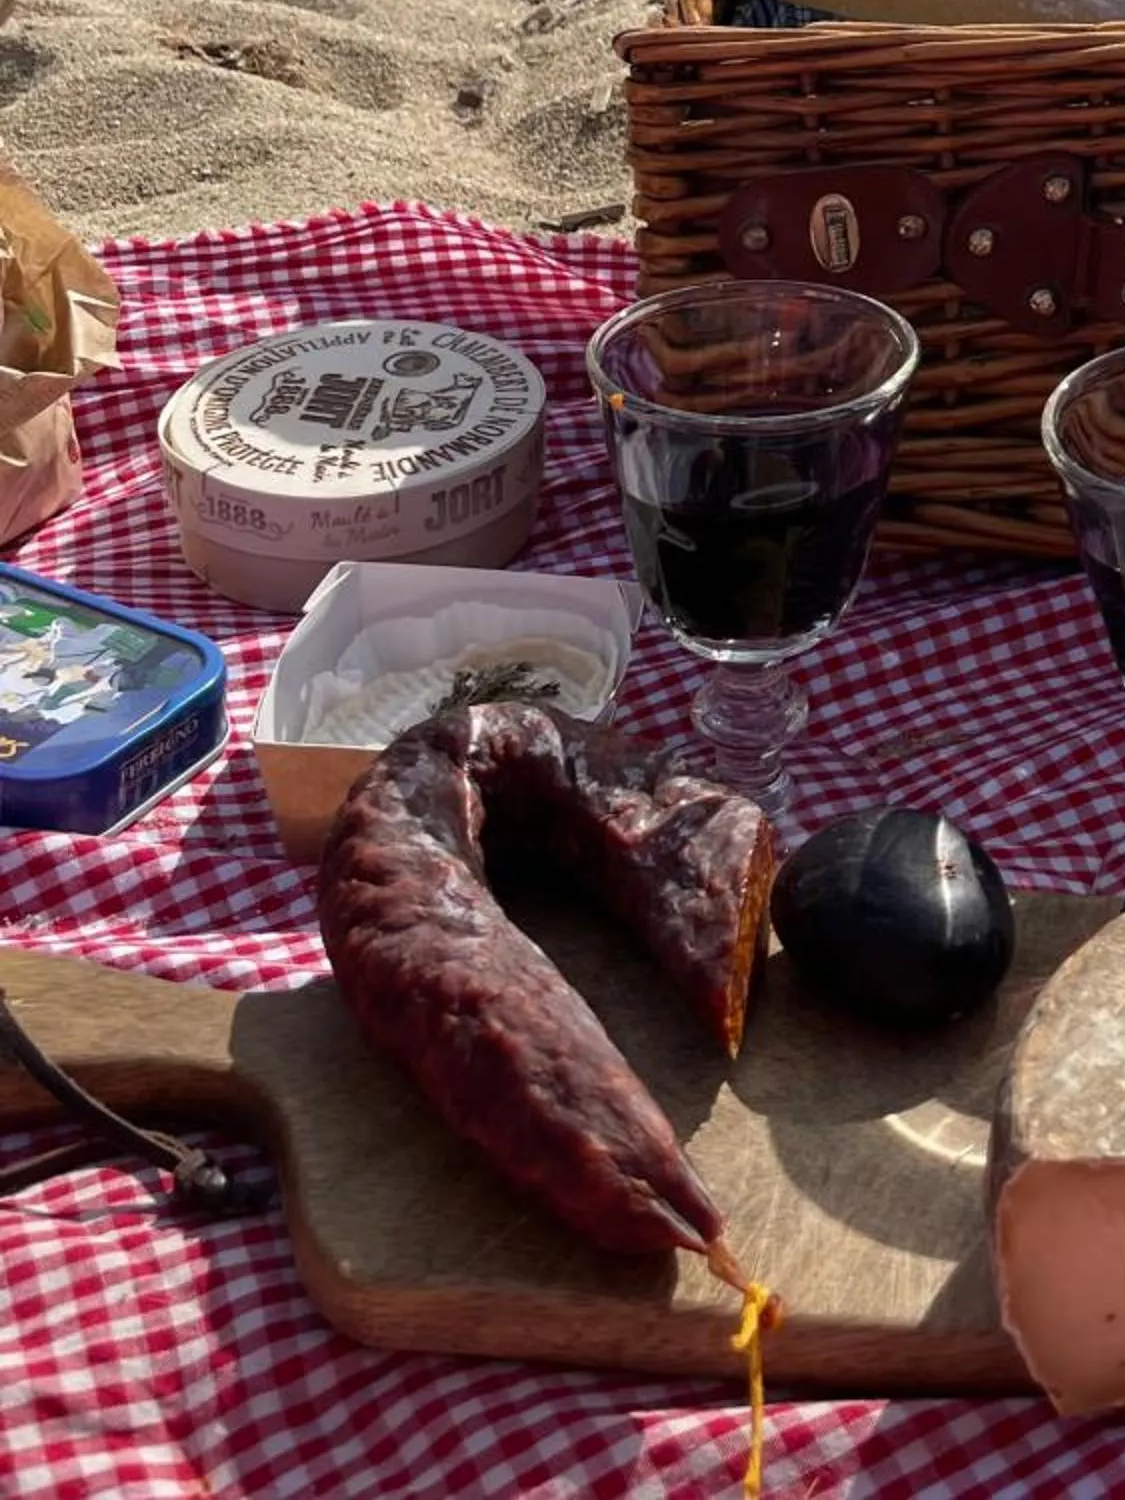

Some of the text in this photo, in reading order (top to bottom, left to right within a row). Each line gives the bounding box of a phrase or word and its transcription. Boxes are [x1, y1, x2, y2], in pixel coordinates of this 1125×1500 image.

[238, 332, 371, 377] APPELLATION
[432, 332, 529, 392] CAMEMBERT
[265, 377, 306, 415] 1888
[300, 374, 368, 429] JORT
[489, 397, 529, 414] DE
[211, 431, 304, 477] PROTÉGÉE
[372, 414, 519, 483] NORMANDIE
[205, 496, 267, 531] 1888
[424, 465, 509, 532] JORT
